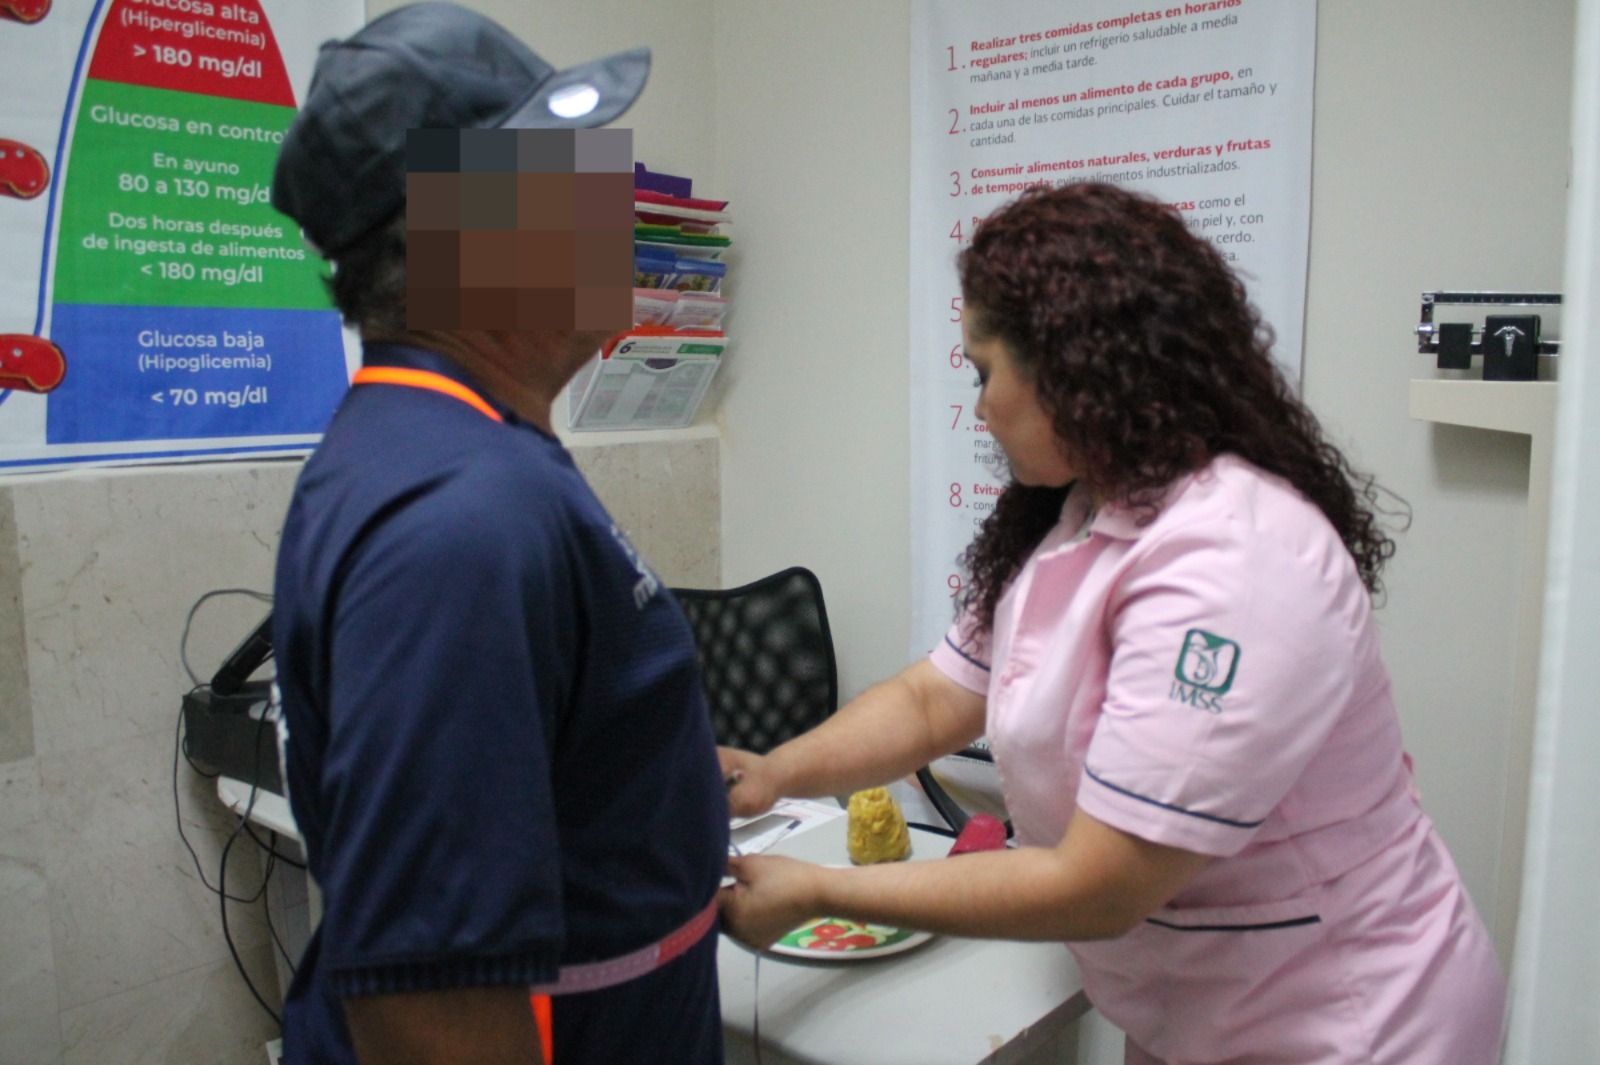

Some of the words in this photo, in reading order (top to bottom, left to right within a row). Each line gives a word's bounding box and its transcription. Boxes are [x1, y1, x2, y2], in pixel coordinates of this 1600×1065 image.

[132, 0, 214, 16] ucosa
[221, 4, 259, 24] alta
[970, 36, 1017, 52] Realizar
[1019, 32, 1042, 44] tres
[1044, 21, 1093, 39] comidas
[1096, 11, 1162, 30] completas
[1165, 7, 1181, 18] en
[1184, 0, 1242, 15] horarios
[121, 8, 266, 50] (Hiperglicemia)
[1030, 45, 1060, 59] incluir
[1063, 42, 1077, 53] un
[1080, 32, 1130, 50] refrigerio
[1133, 22, 1188, 41] saludable
[1190, 22, 1198, 32] a
[1201, 13, 1238, 30] media
[152, 45, 192, 67] 180
[199, 55, 262, 78] mg/dl
[970, 70, 1012, 83] mañana
[1014, 69, 1021, 80] y
[1023, 67, 1030, 77] a
[1032, 60, 1063, 75] media
[1066, 55, 1098, 69] tarde.
[970, 101, 1005, 115] Incluir
[1008, 99, 1019, 111] al
[1021, 96, 1060, 109] menos
[1062, 93, 1077, 103] un
[1079, 84, 1135, 101] alimento
[1137, 80, 1153, 93] de
[1155, 75, 1187, 90] cada
[1190, 70, 1234, 89] grupo,
[1237, 66, 1253, 79] en
[970, 119, 994, 132] cada
[997, 117, 1016, 128] una
[1018, 114, 1031, 126] de
[1034, 113, 1049, 124] las
[1051, 106, 1095, 122] comidas
[1097, 96, 1160, 117] principales.
[1163, 93, 1200, 107] Cuidar
[1203, 89, 1214, 101] el
[1217, 82, 1266, 98] tamaño
[1269, 83, 1278, 96] y
[91, 105, 180, 132] Glucosa
[186, 121, 213, 135] en
[219, 123, 289, 144] contro
[970, 132, 1016, 148] cantidad.
[153, 152, 178, 168] En
[183, 158, 240, 175] ayuno
[971, 163, 1025, 179] Consumir
[1027, 158, 1085, 174] alimentos
[1087, 152, 1150, 168] naturales,
[1153, 145, 1212, 160] verduras
[1215, 143, 1224, 156] y
[1226, 139, 1271, 153] frutas
[118, 173, 149, 192] 80
[155, 179, 168, 194] a
[174, 178, 209, 198] 130
[216, 183, 271, 205] mg/d
[971, 184, 984, 195] de
[1089, 170, 1144, 185] alimentos
[1146, 159, 1240, 178] industrializados.
[1199, 197, 1231, 210] como
[1234, 194, 1245, 206] el
[109, 212, 147, 230] Dos
[153, 215, 204, 233] horas
[209, 220, 283, 240] después
[1202, 214, 1222, 230] piel
[1240, 213, 1264, 225] con
[82, 234, 108, 250] de
[114, 235, 186, 255] ingesta
[191, 240, 214, 255] de
[219, 241, 306, 261] alimentos
[1216, 231, 1256, 244] cerdo.
[159, 261, 195, 280] 180
[202, 264, 263, 286] mg/dl
[138, 330, 218, 348] Glucosa
[223, 331, 265, 351] baja
[138, 353, 272, 373] (Hipoglicemia)
[169, 388, 198, 406] 70
[204, 385, 268, 408] mg/dl
[1168, 680, 1223, 714] IMSS
